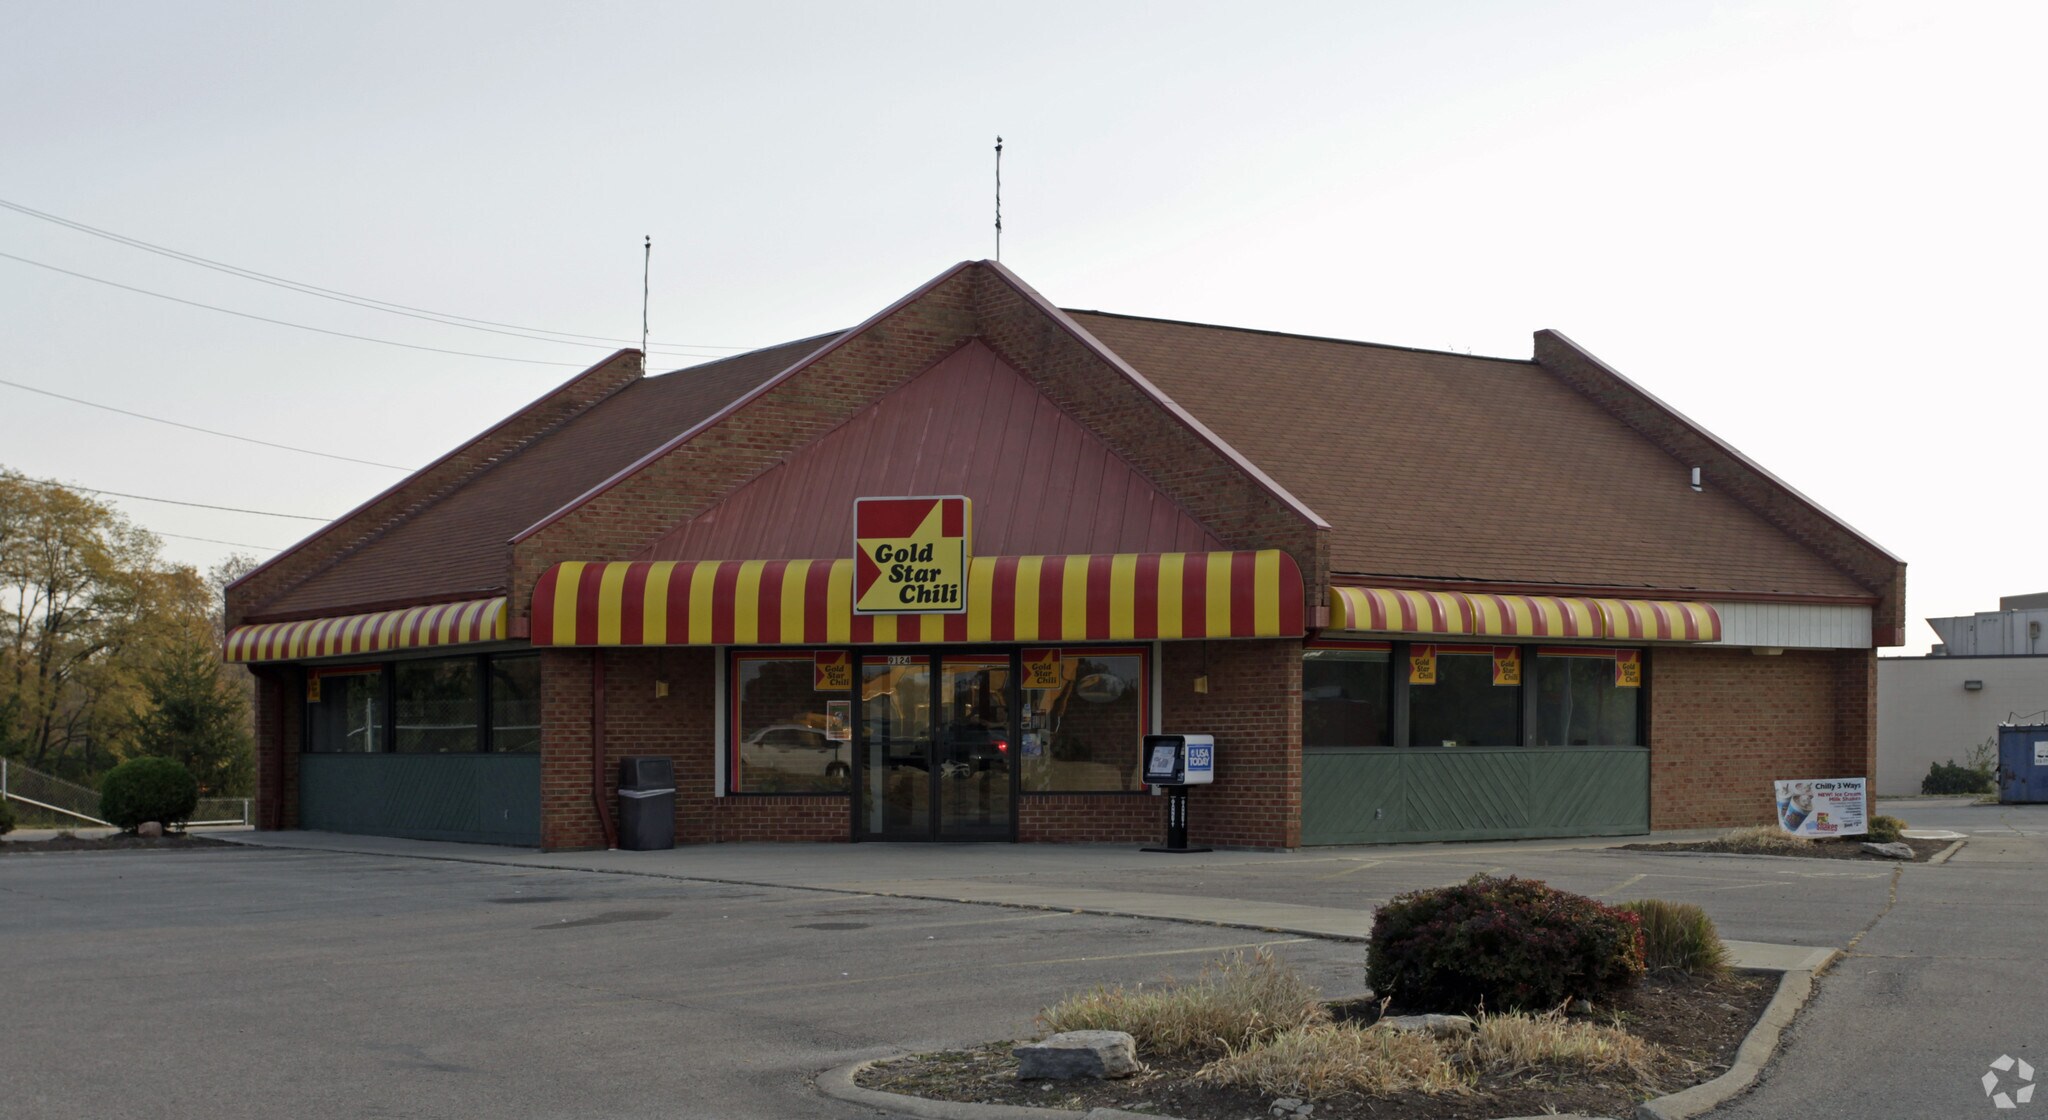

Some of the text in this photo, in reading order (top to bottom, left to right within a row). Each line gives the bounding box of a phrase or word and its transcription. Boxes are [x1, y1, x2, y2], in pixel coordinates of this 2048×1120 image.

[875, 543, 933, 563] Gold
[888, 564, 942, 583] Star
[899, 584, 958, 604] Chili
[889, 656, 910, 664] 9124
[1032, 663, 1051, 671] Gold
[1196, 748, 1210, 758] USA
[1189, 757, 1209, 766] TODAY
